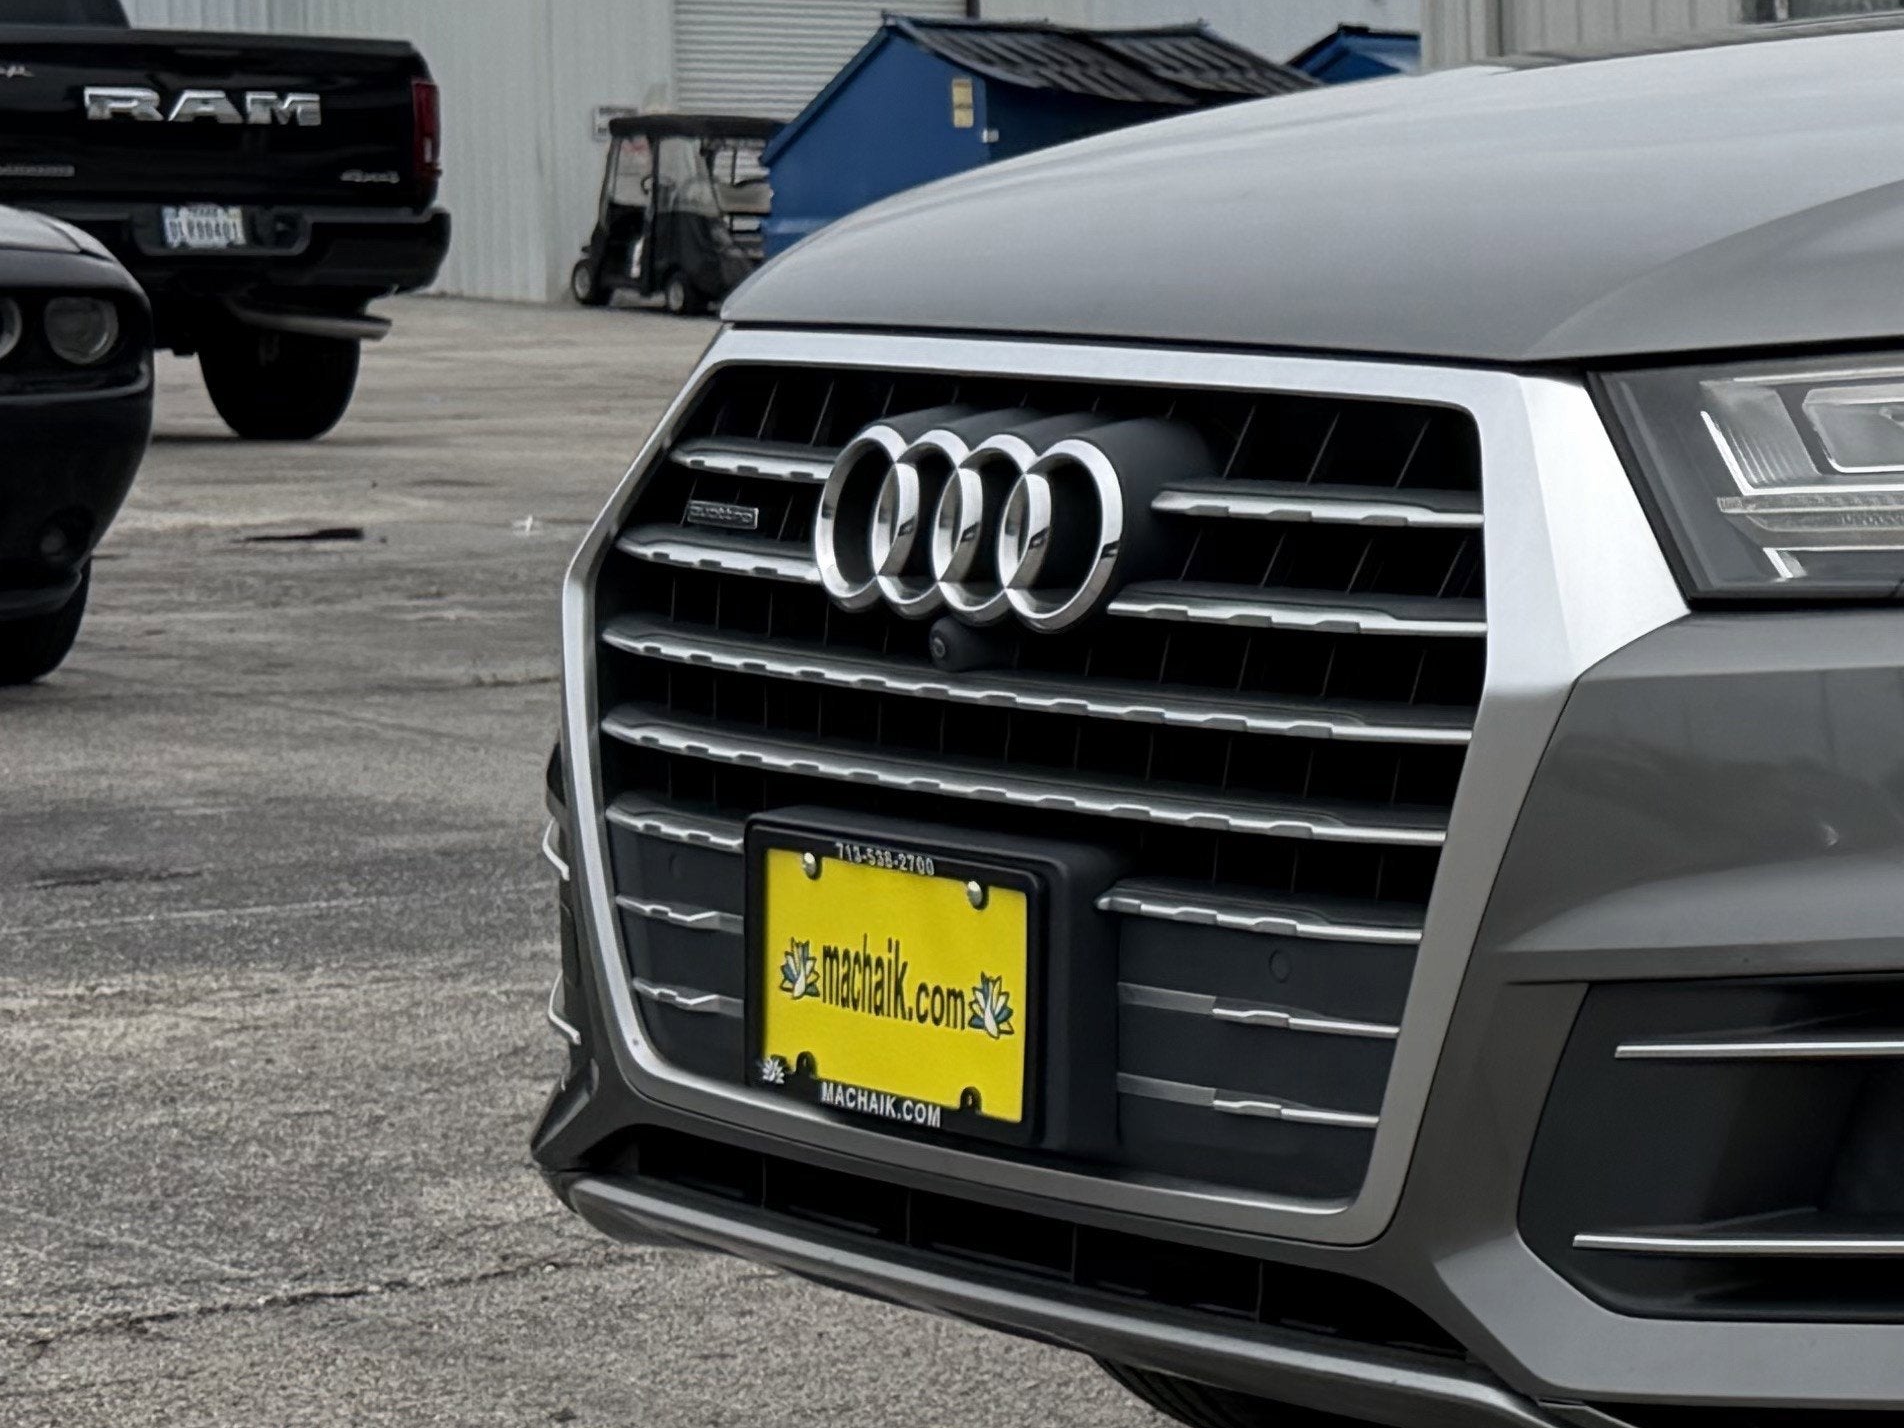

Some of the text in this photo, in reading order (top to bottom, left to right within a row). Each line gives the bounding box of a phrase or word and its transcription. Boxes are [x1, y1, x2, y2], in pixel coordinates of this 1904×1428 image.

[84, 86, 322, 126] RAM
[821, 933, 967, 1030] machaik.com
[820, 1081, 942, 1128] MACHAIK.COM
